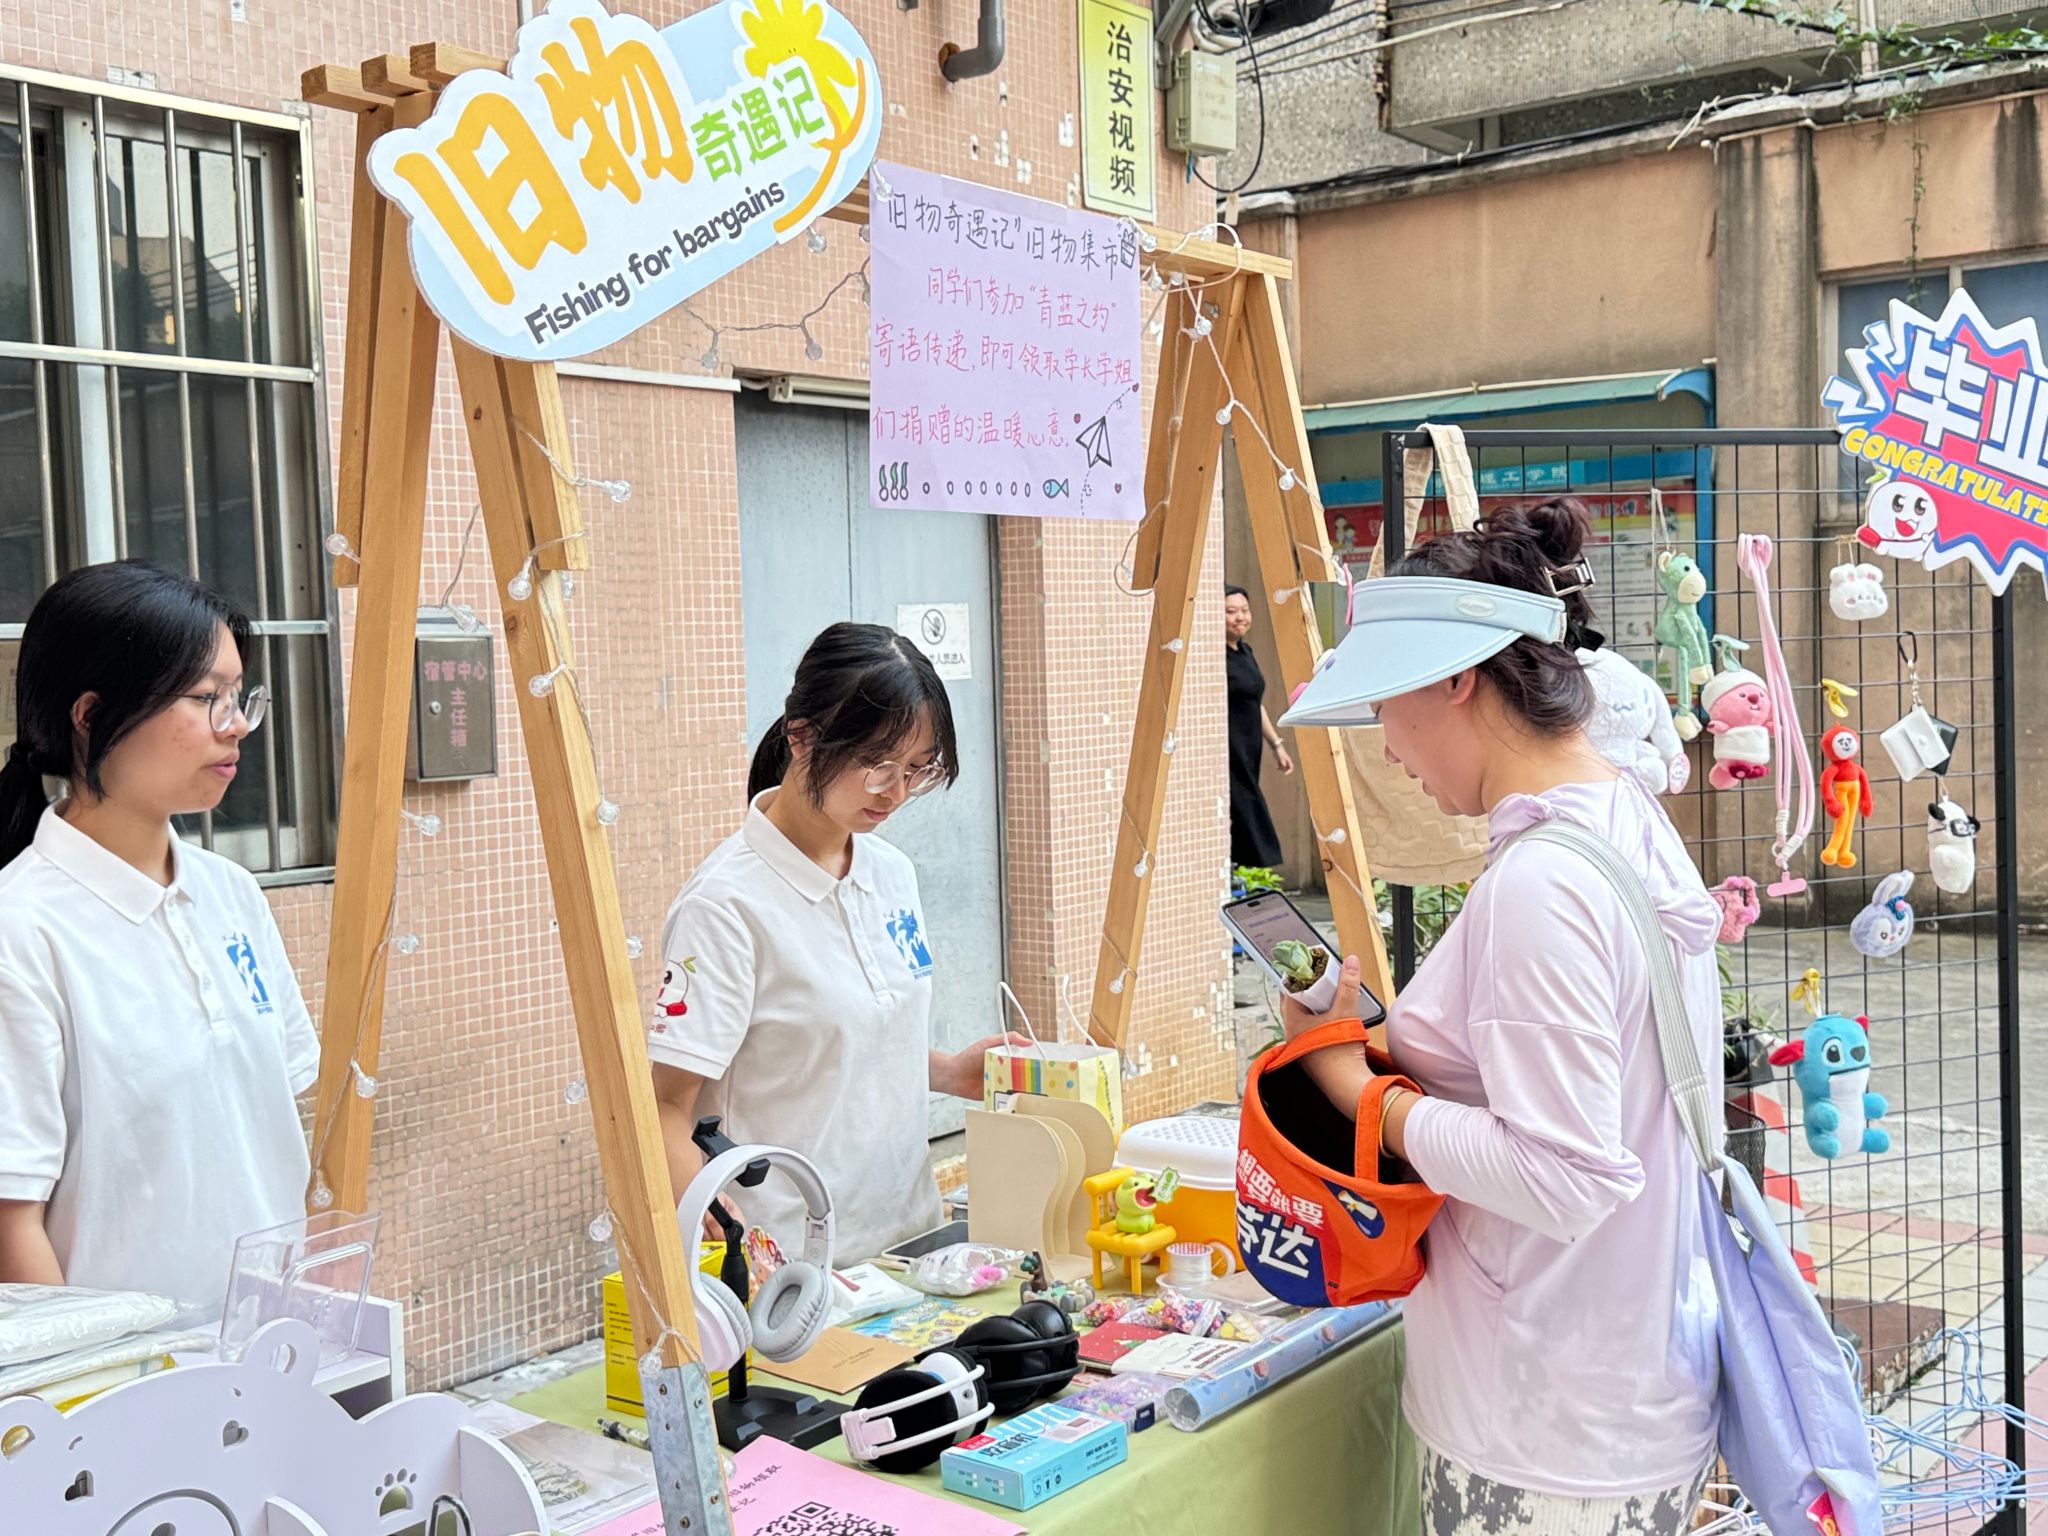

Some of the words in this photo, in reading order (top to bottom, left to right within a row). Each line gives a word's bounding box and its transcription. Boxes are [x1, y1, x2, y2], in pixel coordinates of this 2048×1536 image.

[394, 16, 694, 305] 旧物
[690, 66, 826, 182] 奇遇记
[1107, 21, 1136, 196] 治安视频
[525, 271, 631, 344] Fishing
[628, 242, 672, 285] for
[672, 179, 785, 255] bargains
